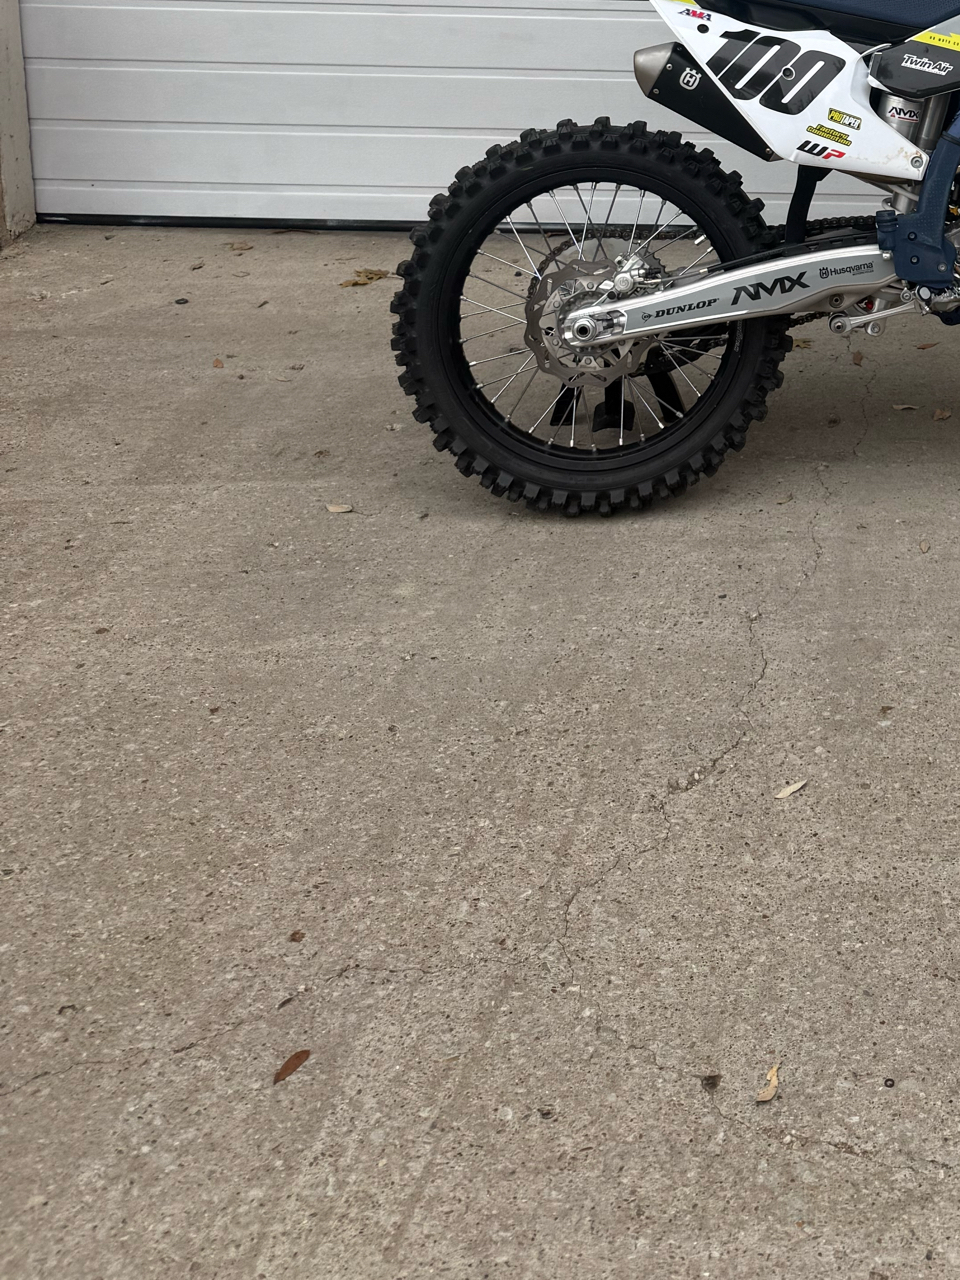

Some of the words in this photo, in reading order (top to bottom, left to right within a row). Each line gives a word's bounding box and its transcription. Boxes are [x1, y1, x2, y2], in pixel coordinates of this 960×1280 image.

[678, 8, 713, 21] AMA
[706, 29, 847, 115] 100
[903, 54, 933, 69] Twin
[932, 61, 953, 73] Air
[888, 106, 920, 119] AMX
[796, 140, 846, 159] WP
[830, 261, 874, 277] Husqvarna
[731, 271, 811, 306] AMX
[654, 298, 718, 318] DUNLOP
